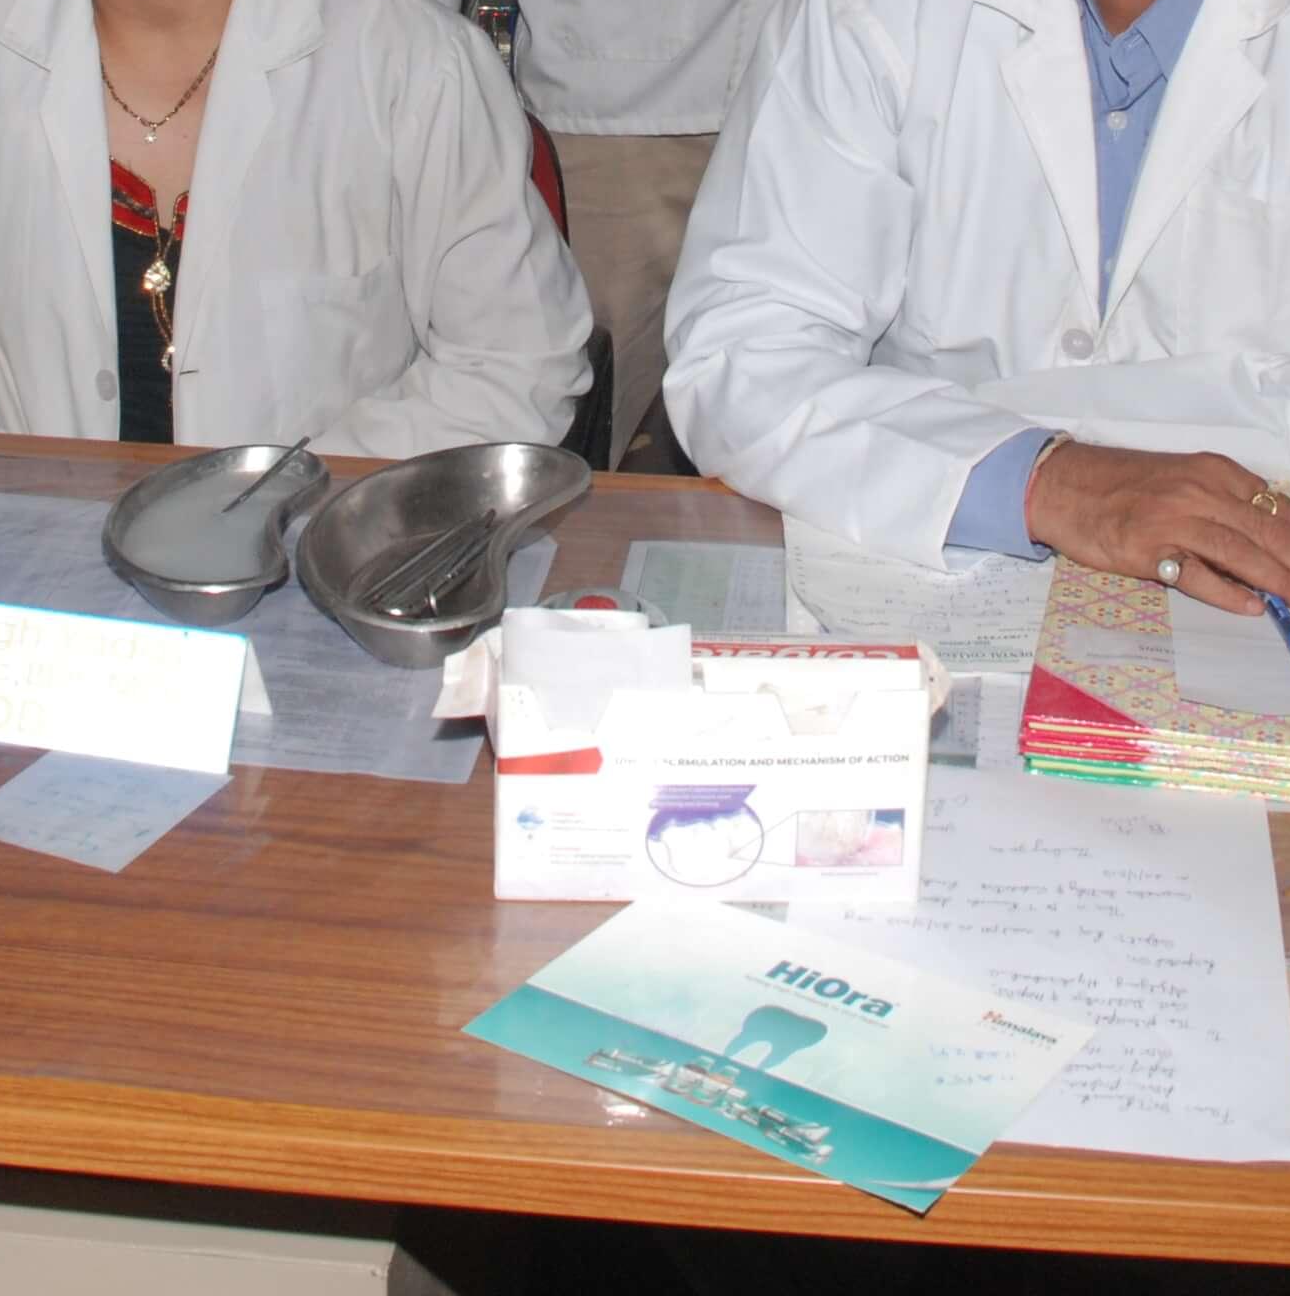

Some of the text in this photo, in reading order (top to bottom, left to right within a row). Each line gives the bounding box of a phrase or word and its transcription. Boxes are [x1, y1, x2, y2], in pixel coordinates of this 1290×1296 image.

[748, 757, 775, 768] AND
[776, 755, 846, 767] MECHANISM
[848, 754, 864, 765] OF
[865, 753, 911, 765] ACTION
[764, 959, 895, 1019] HiOra
